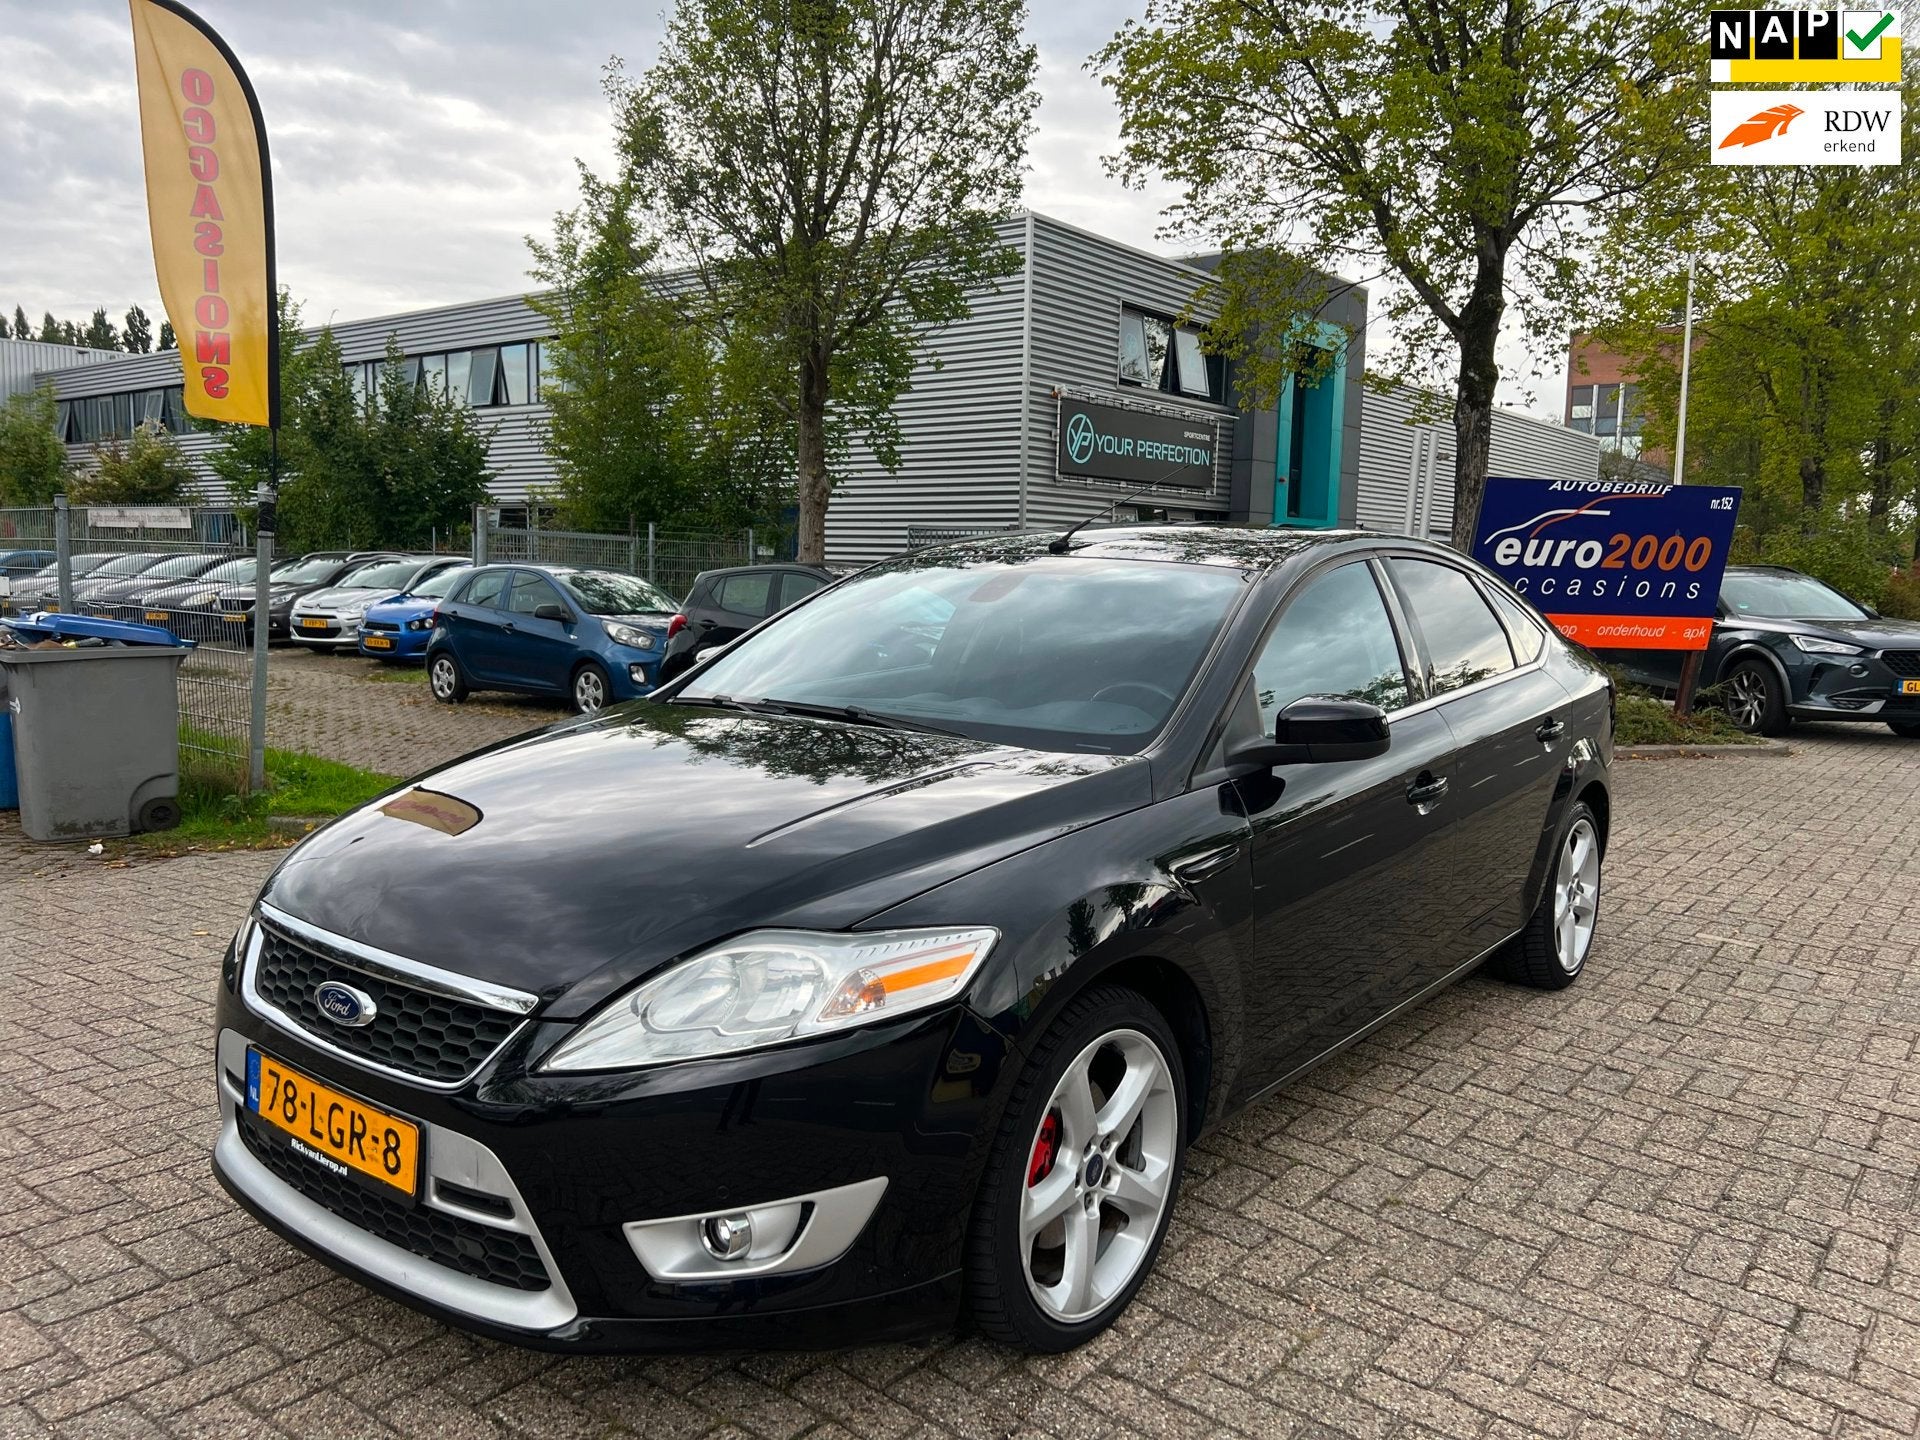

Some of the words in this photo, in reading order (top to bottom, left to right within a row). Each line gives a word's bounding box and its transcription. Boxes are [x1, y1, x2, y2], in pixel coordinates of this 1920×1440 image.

[1095, 434, 1134, 456] YOUR
[1136, 439, 1210, 466] PERFECTION
[1549, 480, 1673, 496] AUTOBEDRIJF
[1710, 497, 1733, 511] nr.152
[1494, 533, 1712, 573] euro2000
[1514, 575, 1701, 600] ccasions
[1596, 624, 1666, 638] onderhoud
[1682, 627, 1707, 641] apk
[1907, 682, 1920, 692] GL
[323, 990, 351, 1016] Ford
[249, 1084, 260, 1102] NL
[267, 1069, 402, 1176] 78-LGR-8
